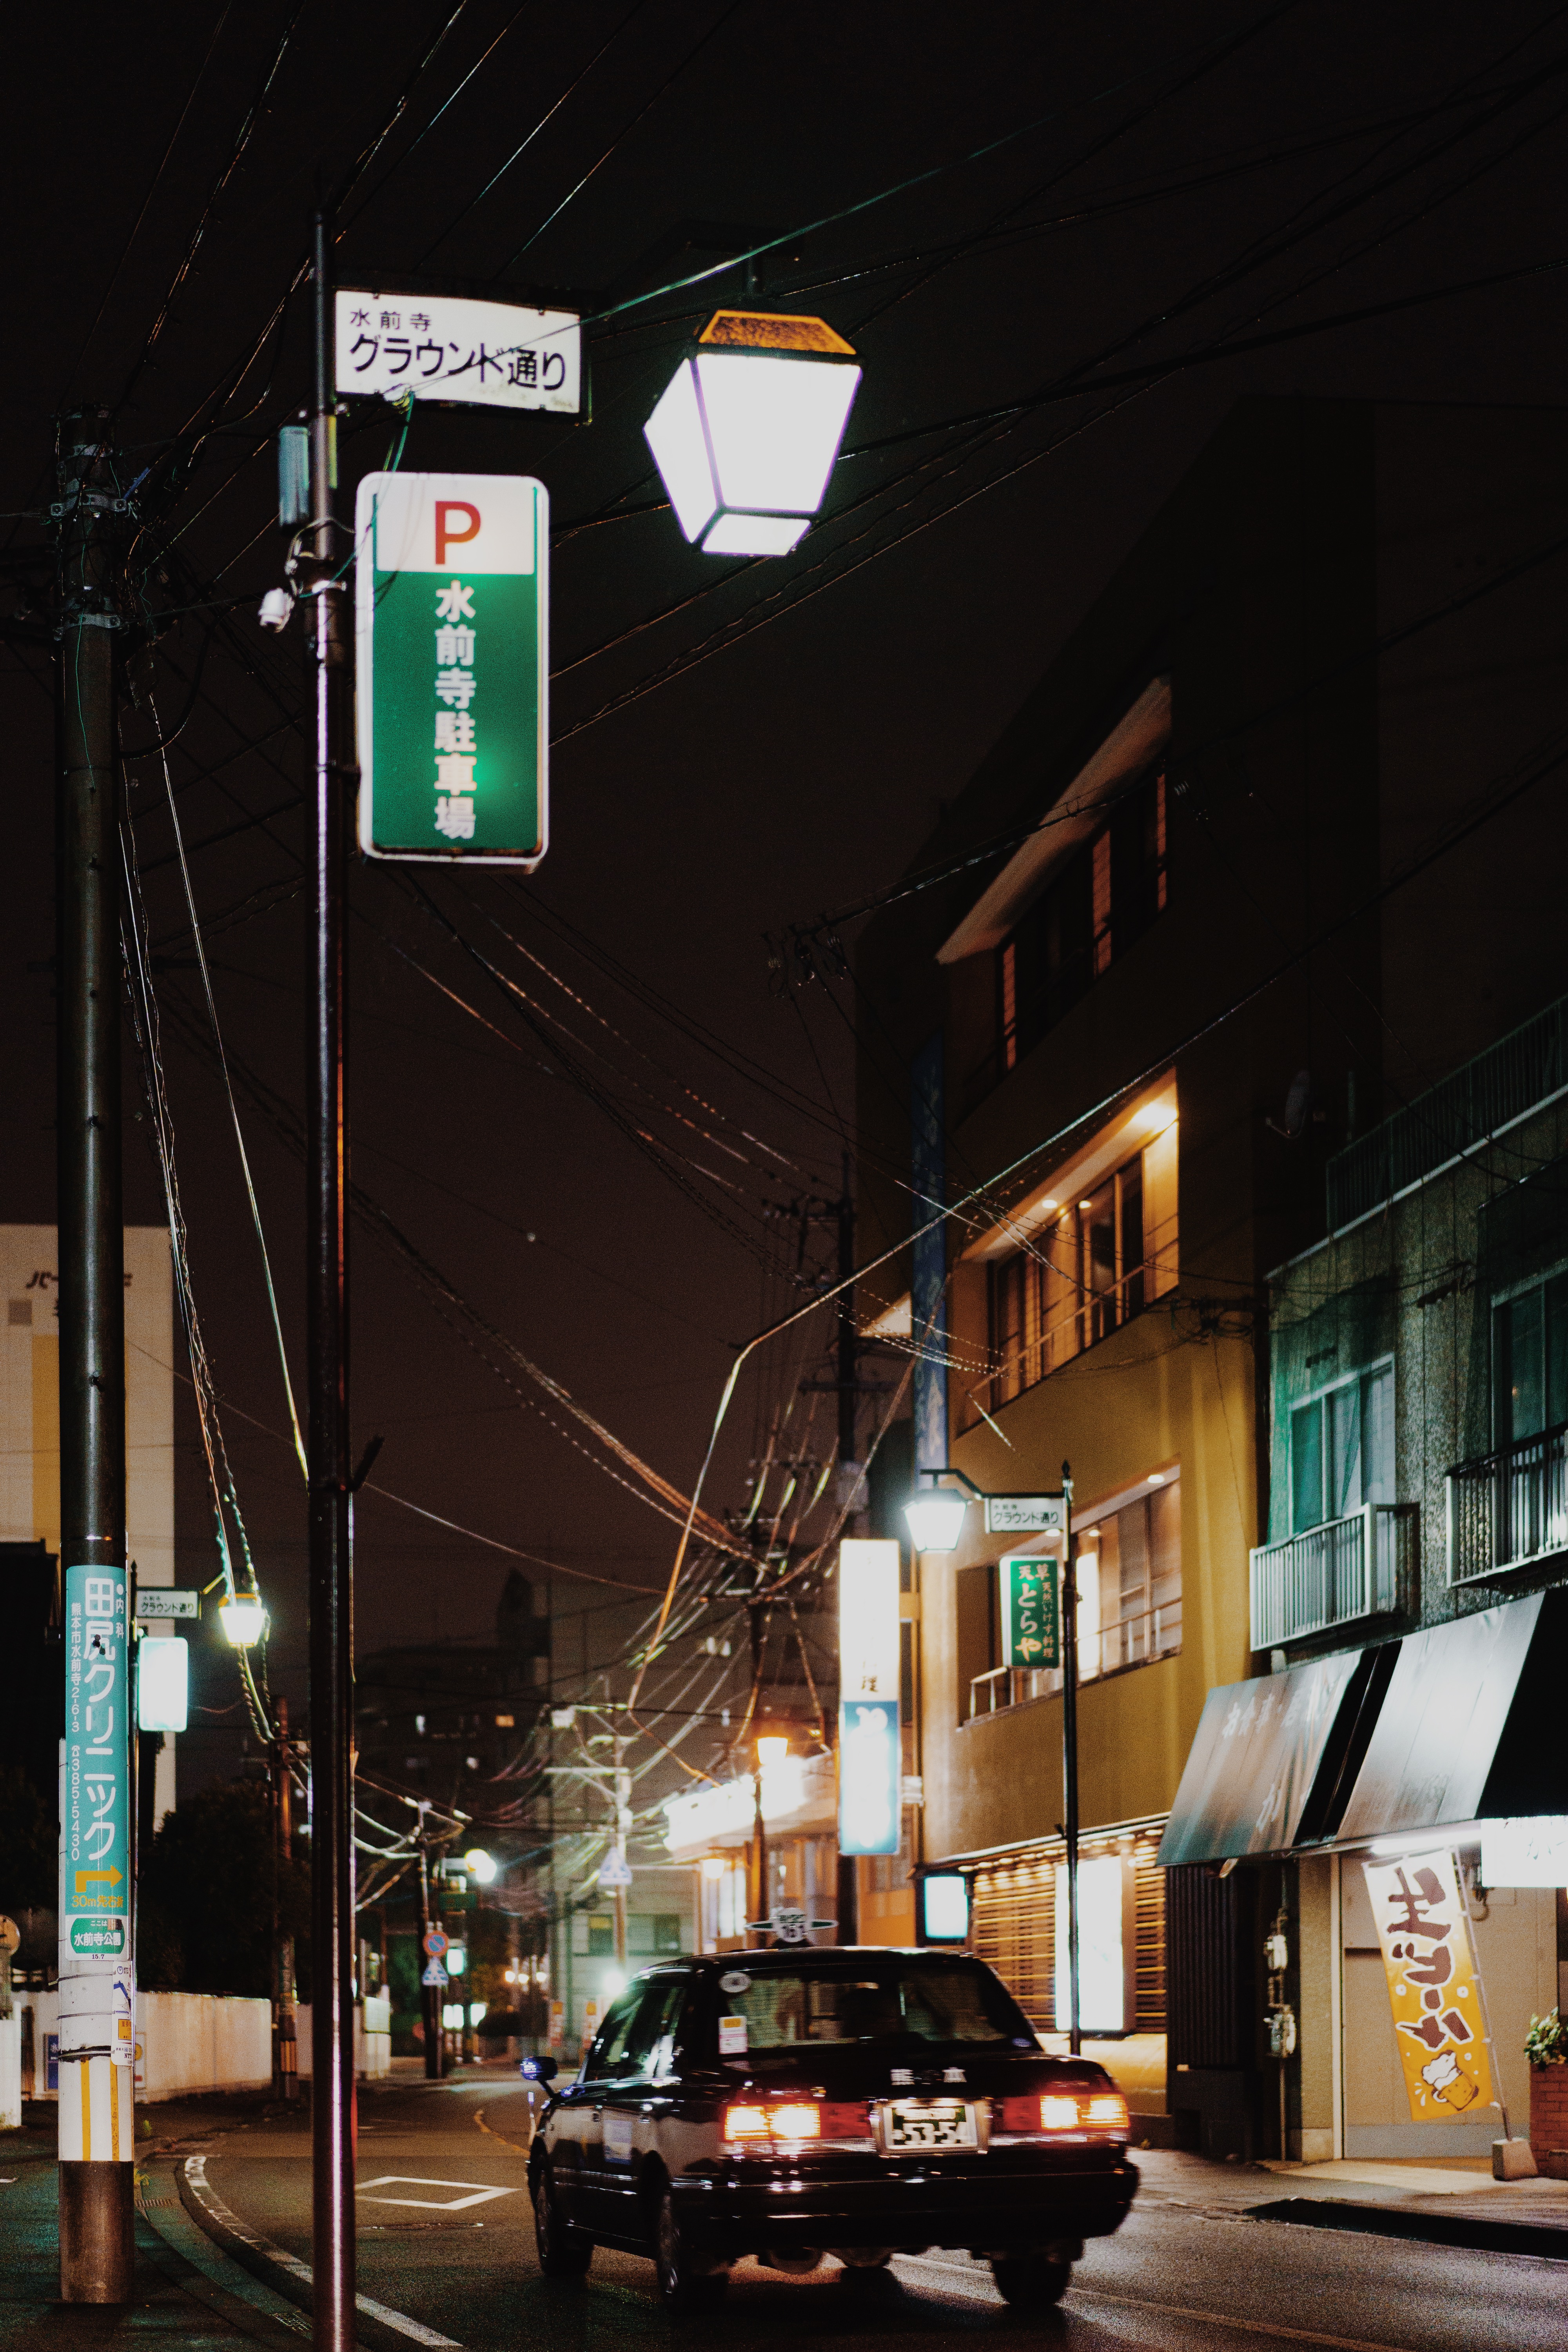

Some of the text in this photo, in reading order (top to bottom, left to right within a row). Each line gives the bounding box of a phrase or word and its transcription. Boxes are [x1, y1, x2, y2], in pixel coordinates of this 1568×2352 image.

[350, 308, 431, 331] 水前寺
[350, 334, 566, 391] グラウンド通り
[435, 501, 481, 565] P
[434, 579, 477, 839] 水前寺駐車場
[116, 1598, 124, 1639] 内科
[1015, 1583, 1042, 1662] とらや
[83, 1578, 116, 1860] 田尻クリニック
[72, 1895, 123, 1908] 30m先右折
[74, 1932, 121, 1946] 水前寺公園
